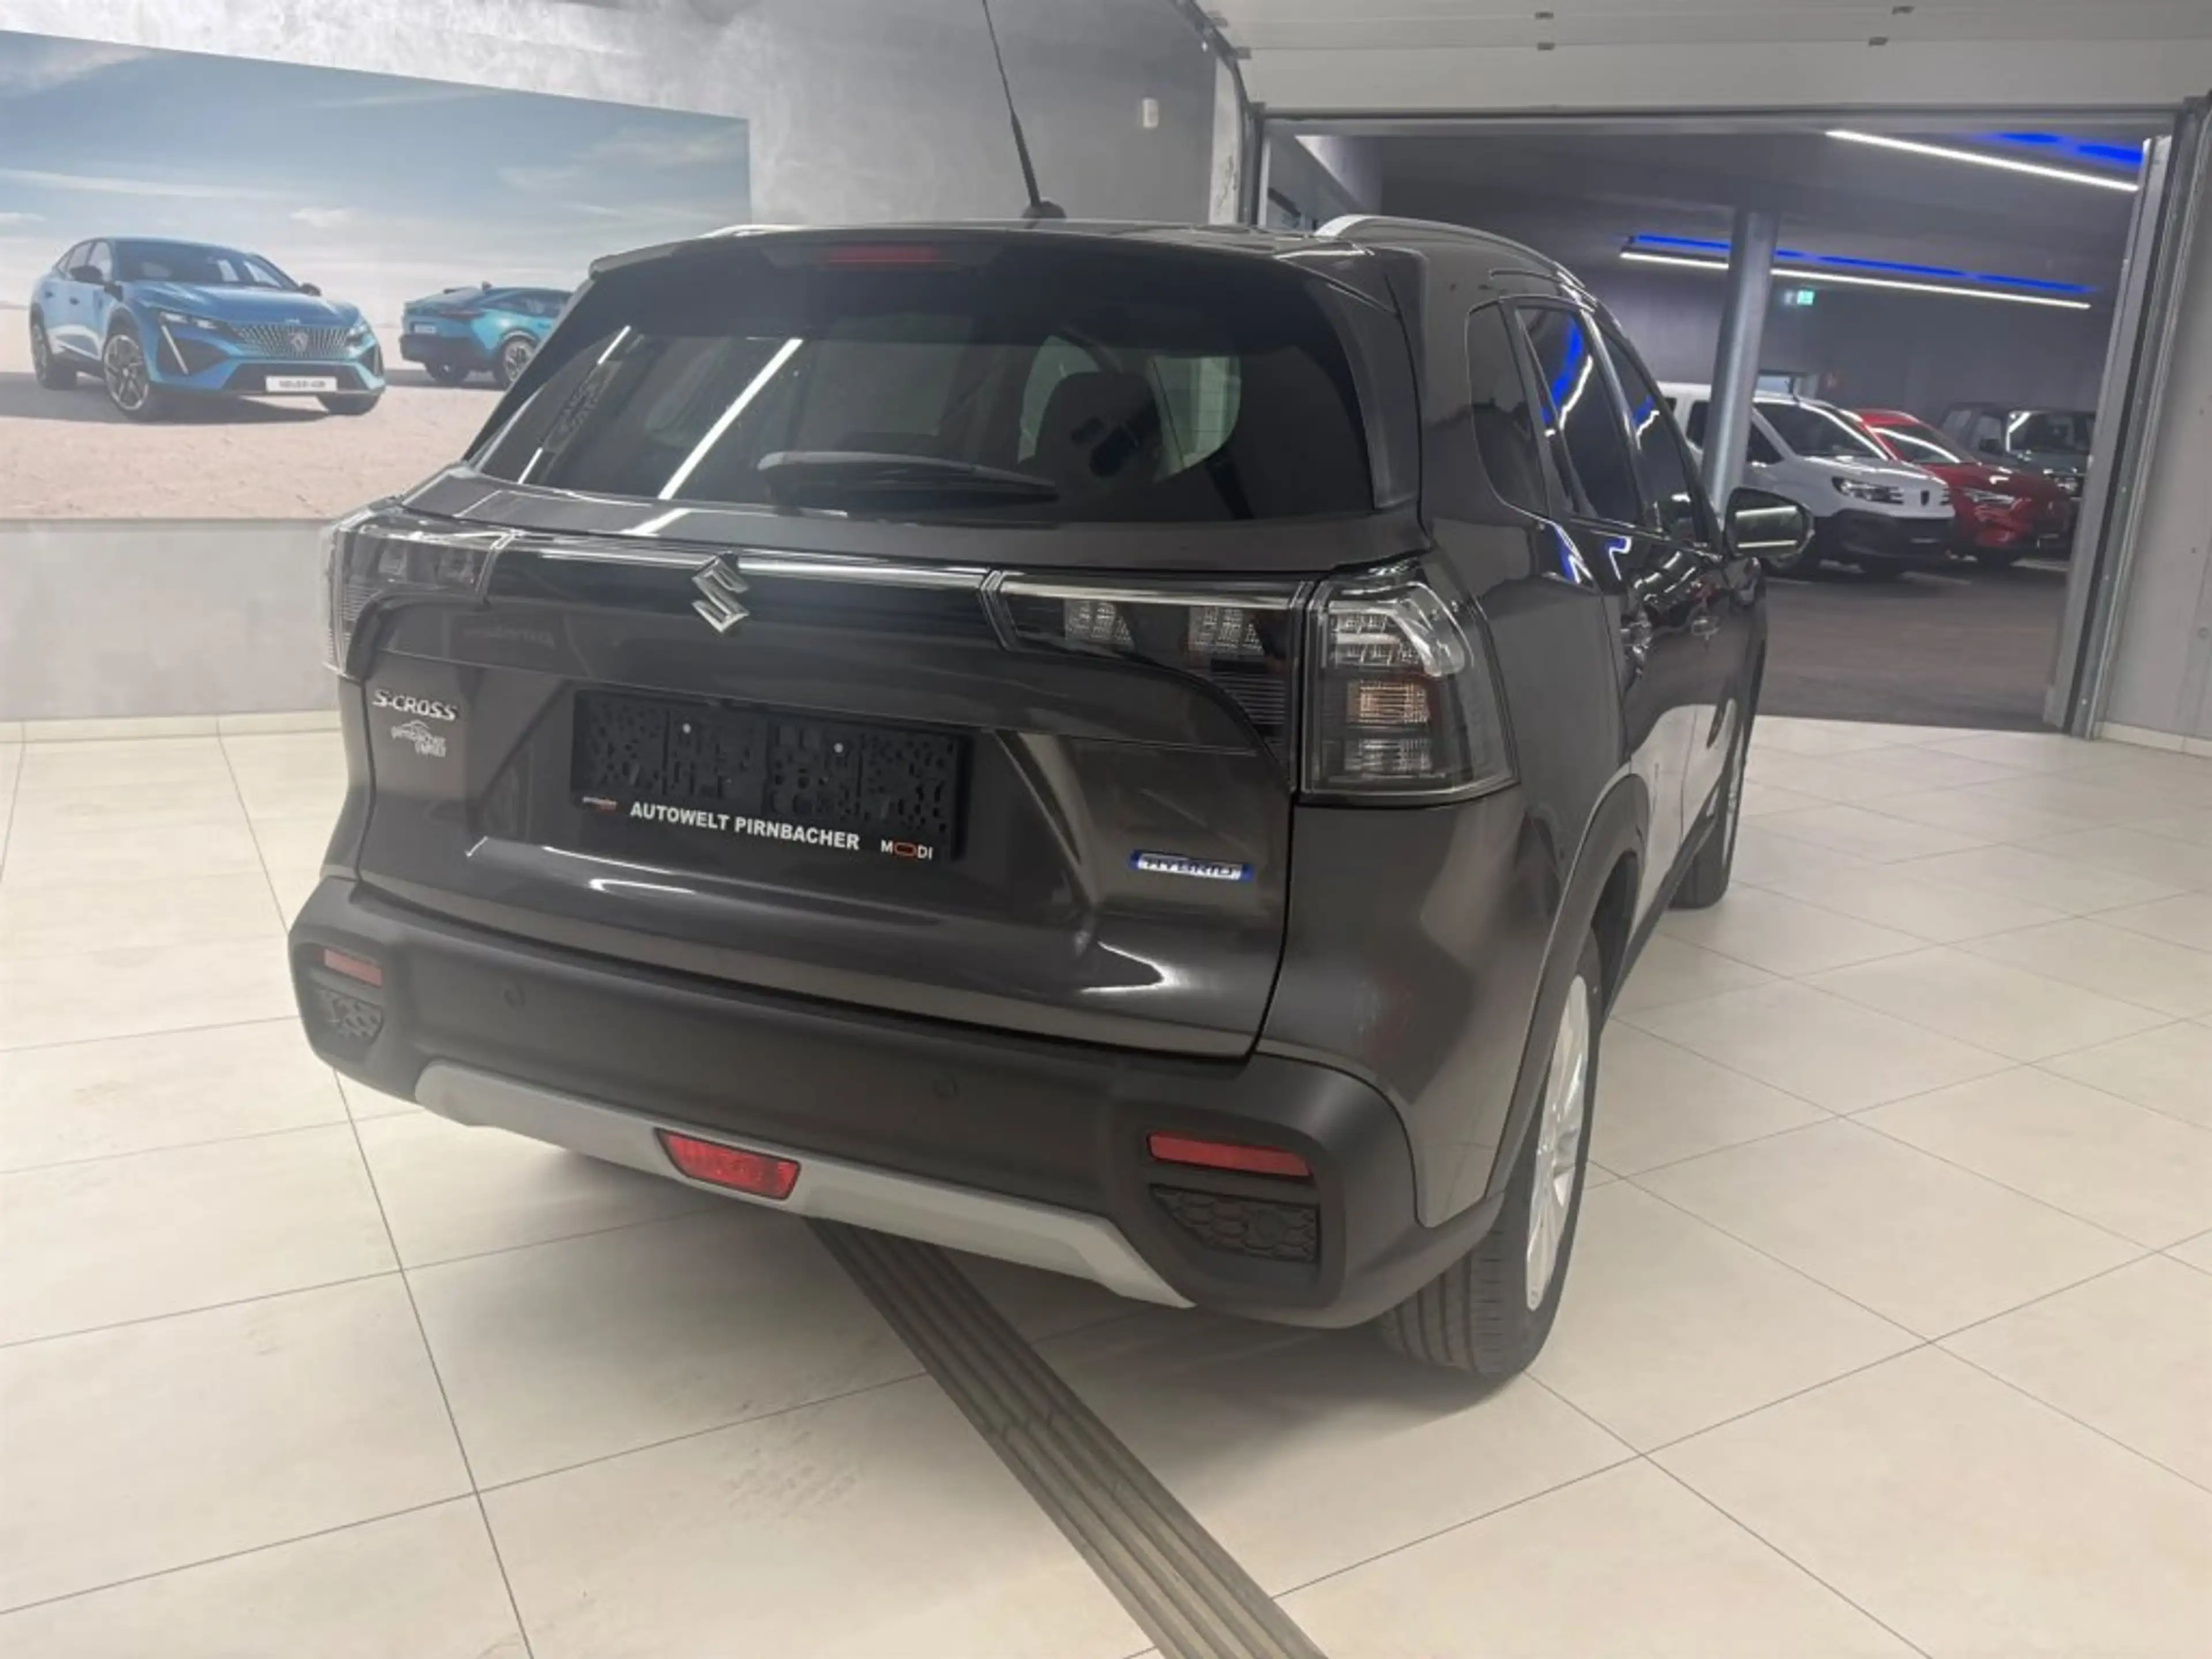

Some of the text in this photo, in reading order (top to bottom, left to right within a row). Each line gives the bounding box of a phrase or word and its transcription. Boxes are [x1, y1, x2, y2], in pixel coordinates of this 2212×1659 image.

[373, 689, 459, 721] S-CROSS
[630, 801, 730, 831] AUTOWELT
[734, 816, 860, 850] PIRNBACHER
